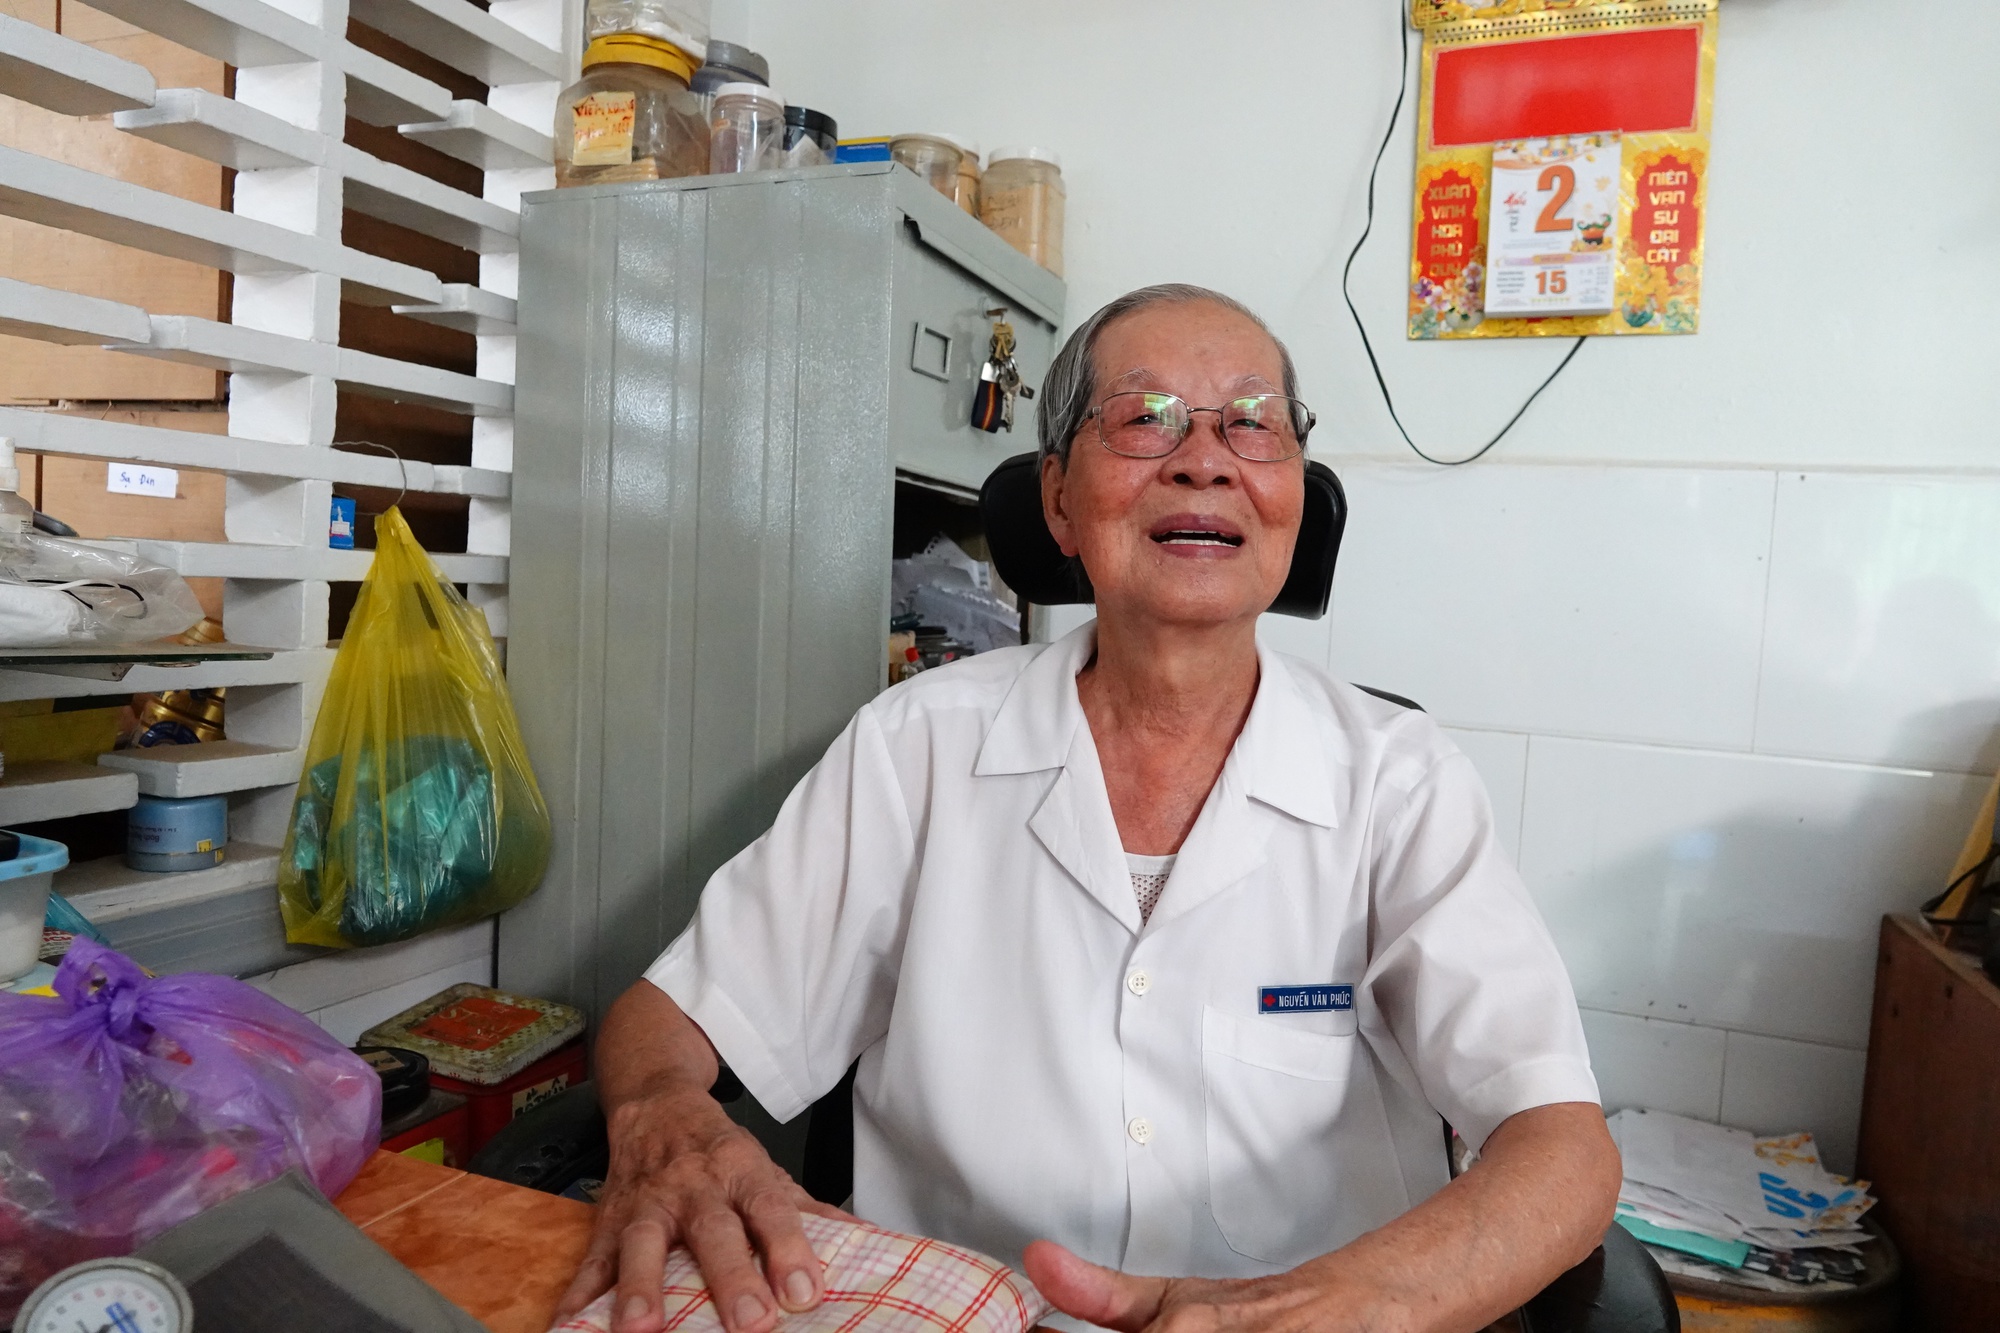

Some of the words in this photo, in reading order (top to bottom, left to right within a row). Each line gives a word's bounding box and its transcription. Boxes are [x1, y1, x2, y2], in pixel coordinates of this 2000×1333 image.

[1534, 164, 1576, 233] 2
[1431, 224, 1463, 239] HOA
[1535, 270, 1567, 295] 15
[1312, 991, 1327, 1006] VĂN
[1330, 991, 1350, 1005] PHÚC
